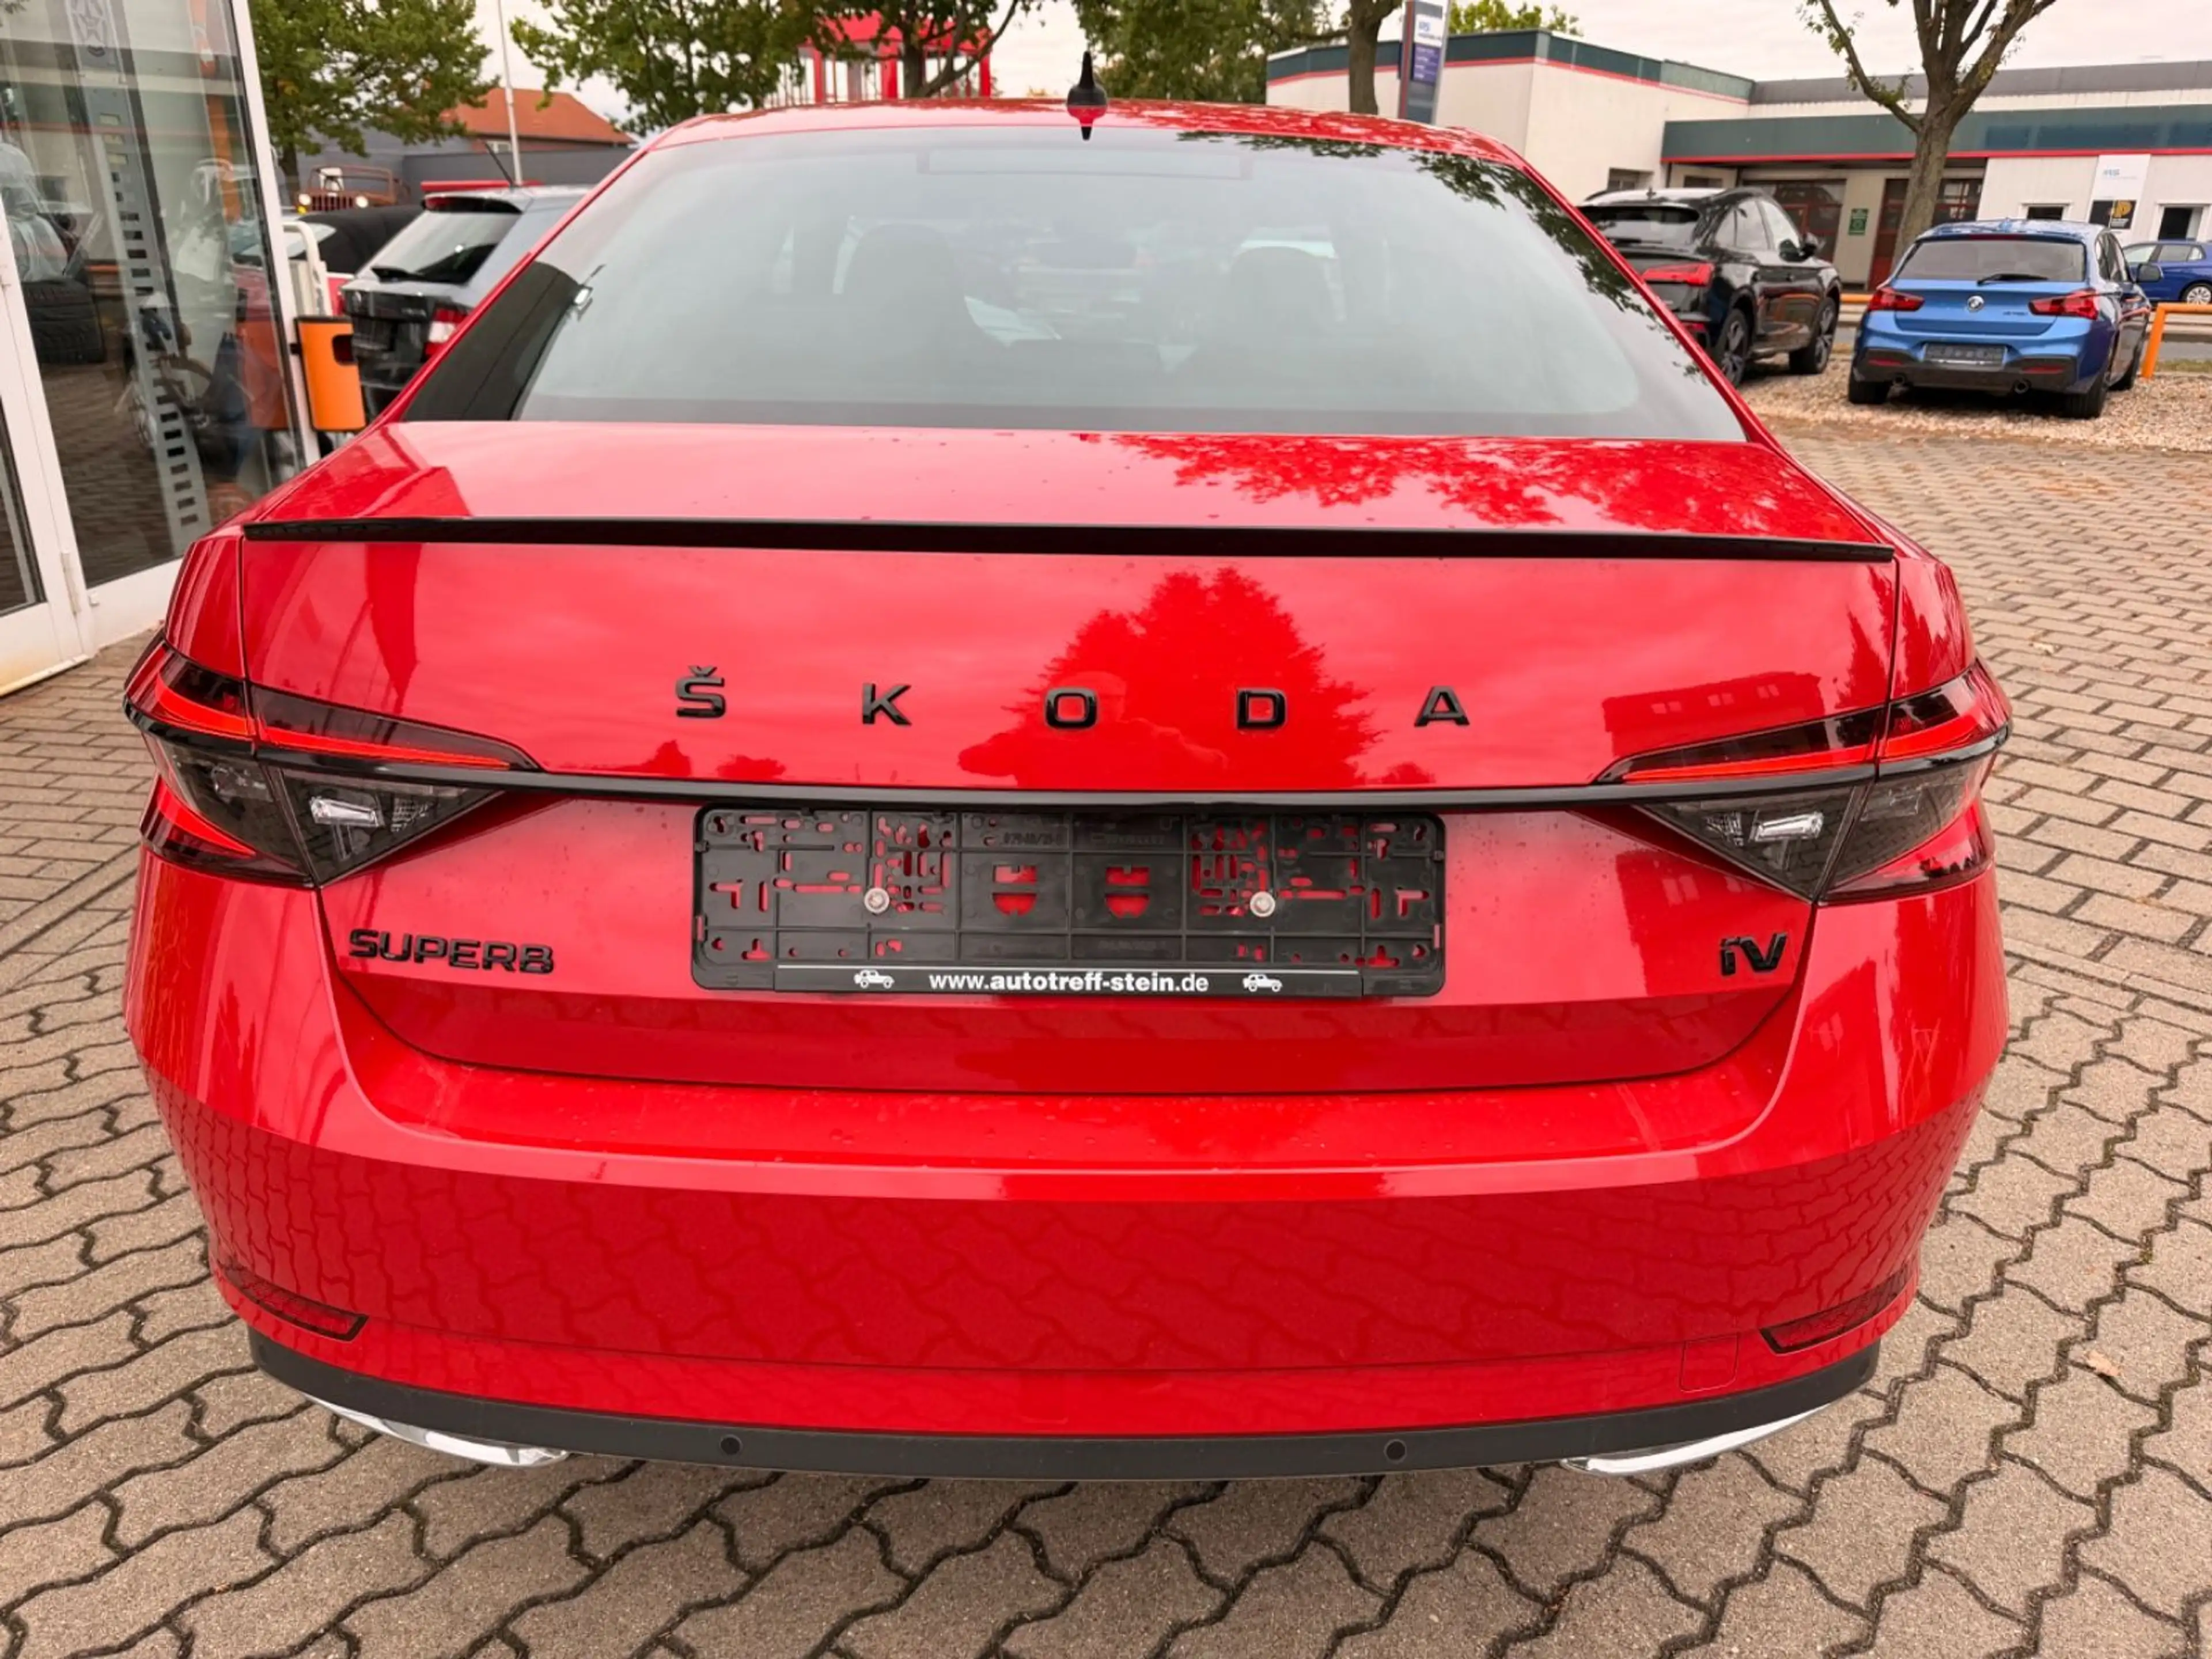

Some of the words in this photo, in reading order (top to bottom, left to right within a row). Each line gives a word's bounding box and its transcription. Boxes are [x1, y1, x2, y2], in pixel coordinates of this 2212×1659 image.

[675, 665, 1470, 730] ŠKODA
[348, 928, 554, 974] SUPERB
[929, 970, 1209, 993] www.autotreff-stein.de
